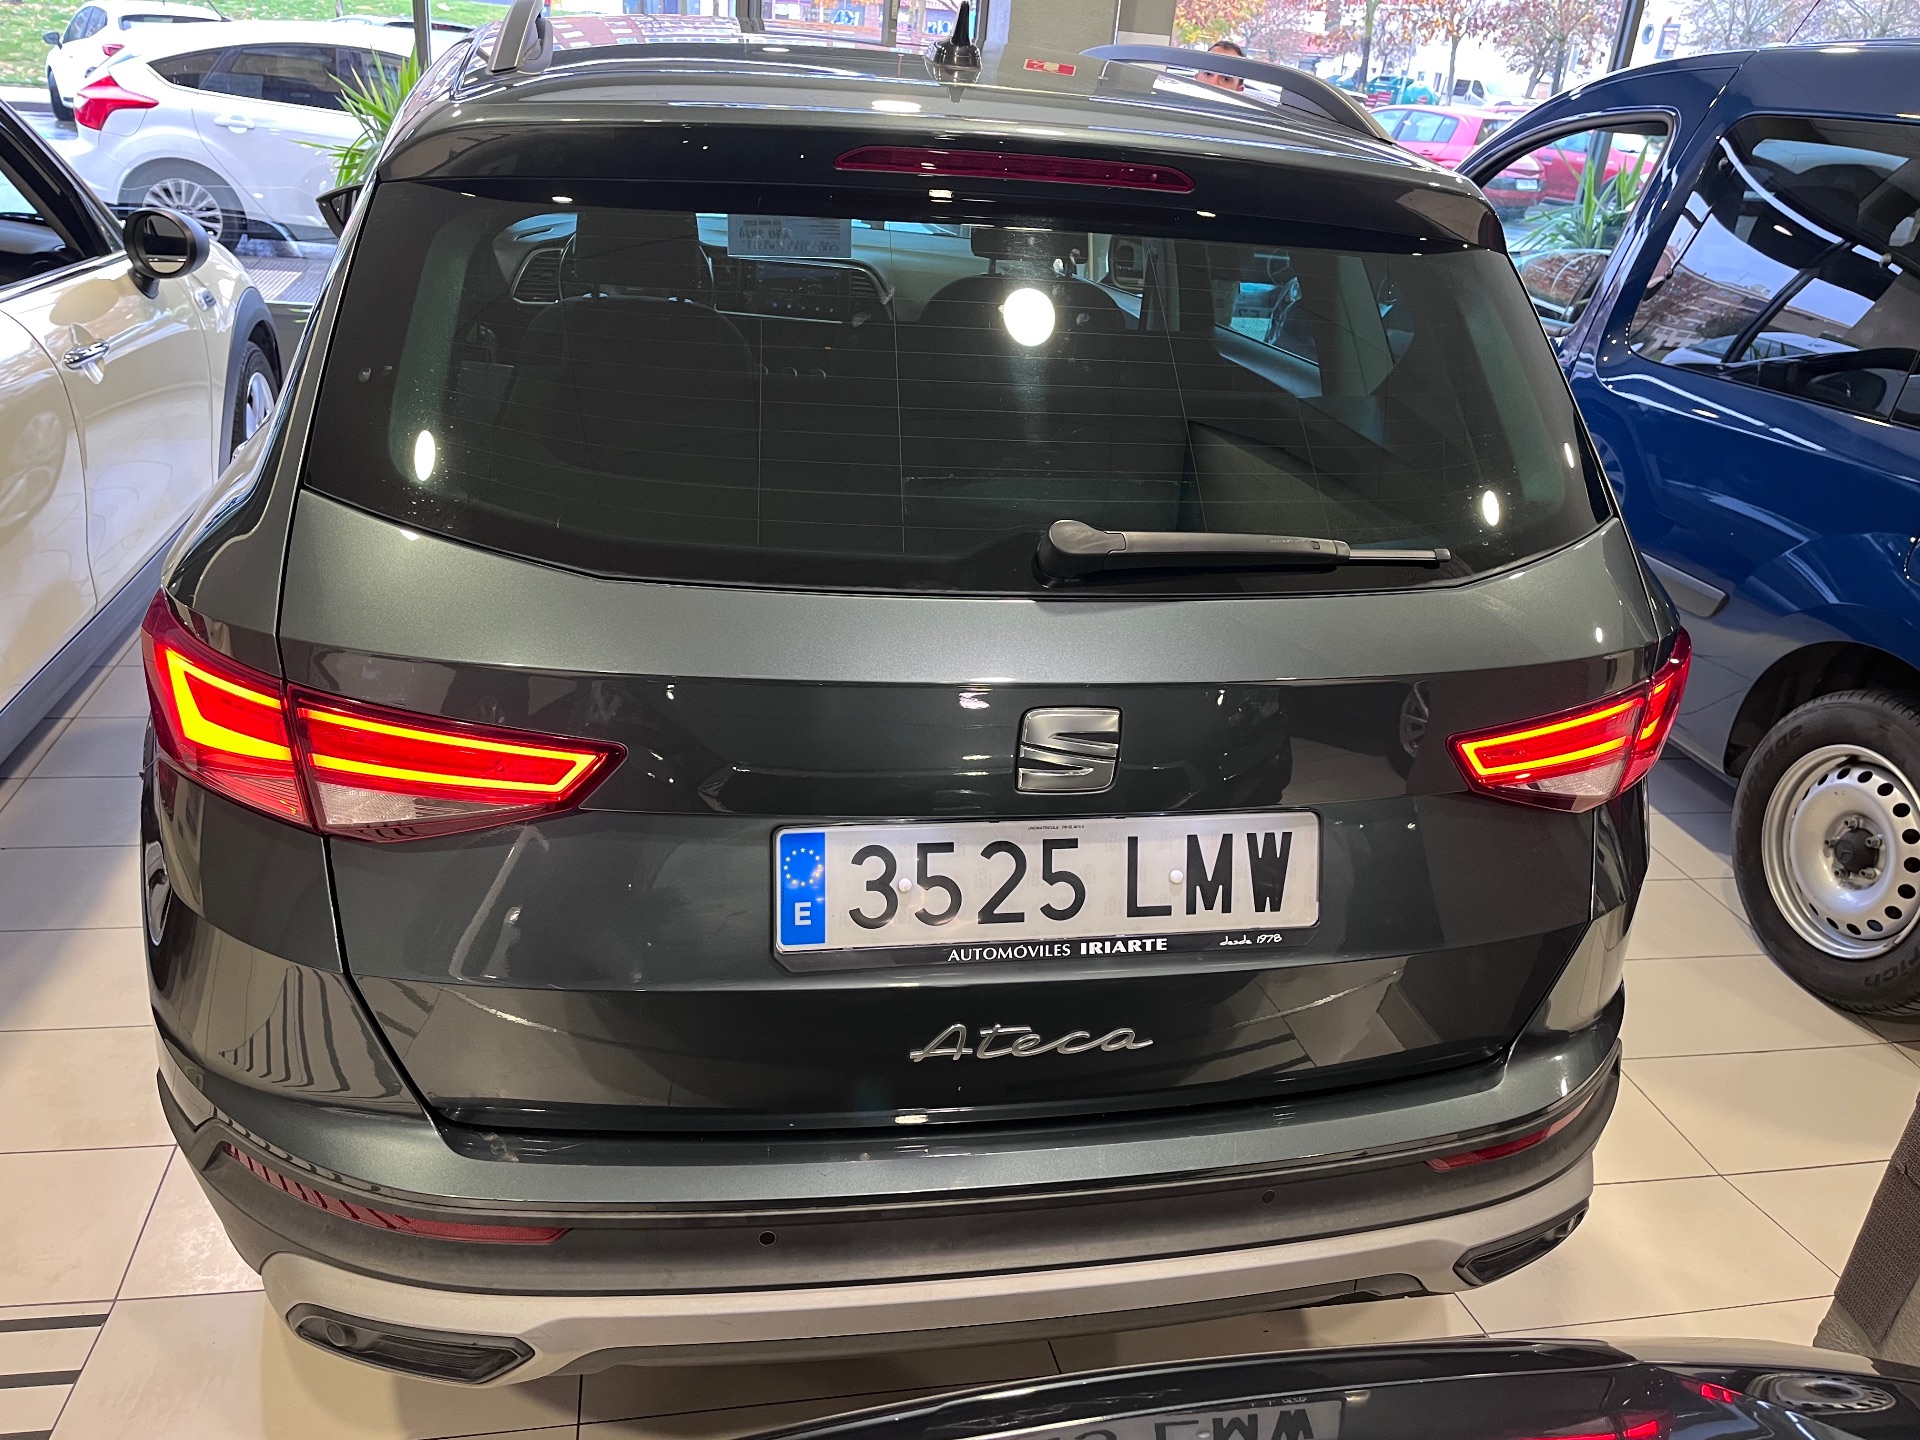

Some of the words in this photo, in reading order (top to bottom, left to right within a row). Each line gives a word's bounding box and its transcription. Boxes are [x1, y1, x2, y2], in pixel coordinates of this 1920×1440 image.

[848, 837, 1087, 930] 3525
[1126, 831, 1292, 918] LMW
[793, 901, 812, 926] E
[947, 943, 1071, 962] AUTOMÓVILES
[1079, 937, 1168, 956] IRIARTE
[1219, 936, 1252, 947] desde
[1255, 933, 1282, 944] 1978
[909, 1023, 1153, 1063] Ateca
